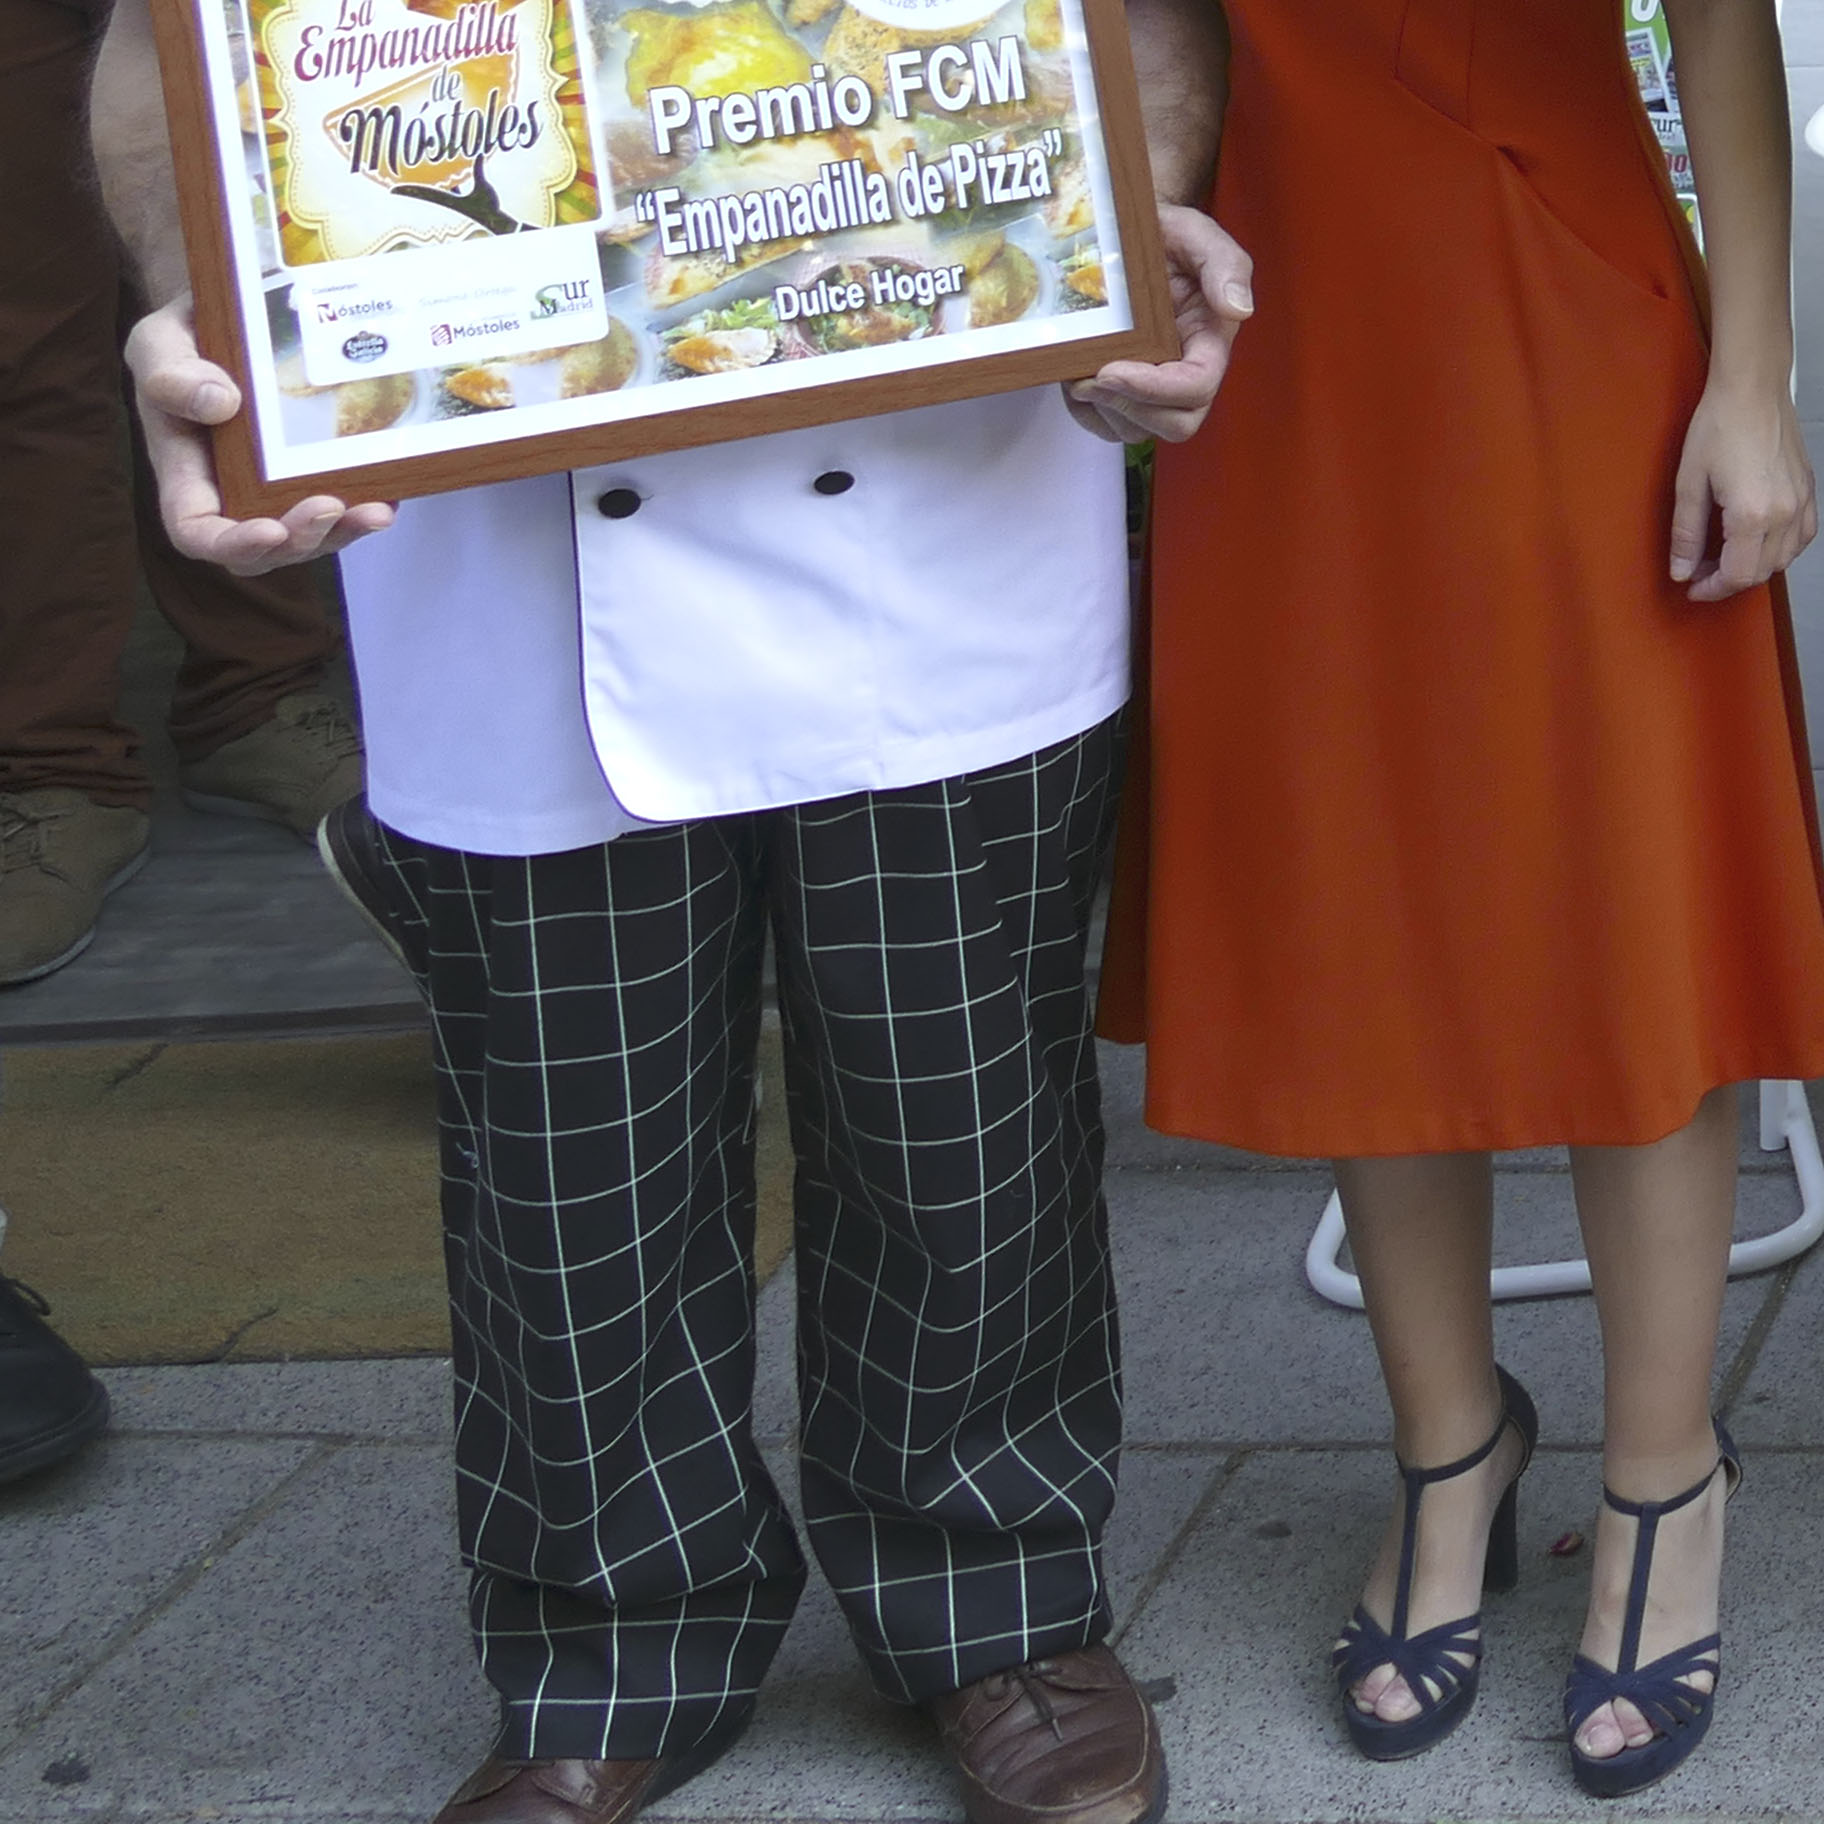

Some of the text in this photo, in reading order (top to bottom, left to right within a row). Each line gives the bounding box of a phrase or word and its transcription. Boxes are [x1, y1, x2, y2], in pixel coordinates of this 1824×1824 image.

[294, 1, 518, 88] Empanadilla
[432, 64, 461, 104] de
[340, 89, 542, 176] Móstoles
[648, 35, 1027, 155] Premio FCM
[635, 128, 1062, 264] “Empanadilla de Pizza”
[453, 317, 520, 340] Móstoles
[774, 264, 965, 321] Dulce Hogar
